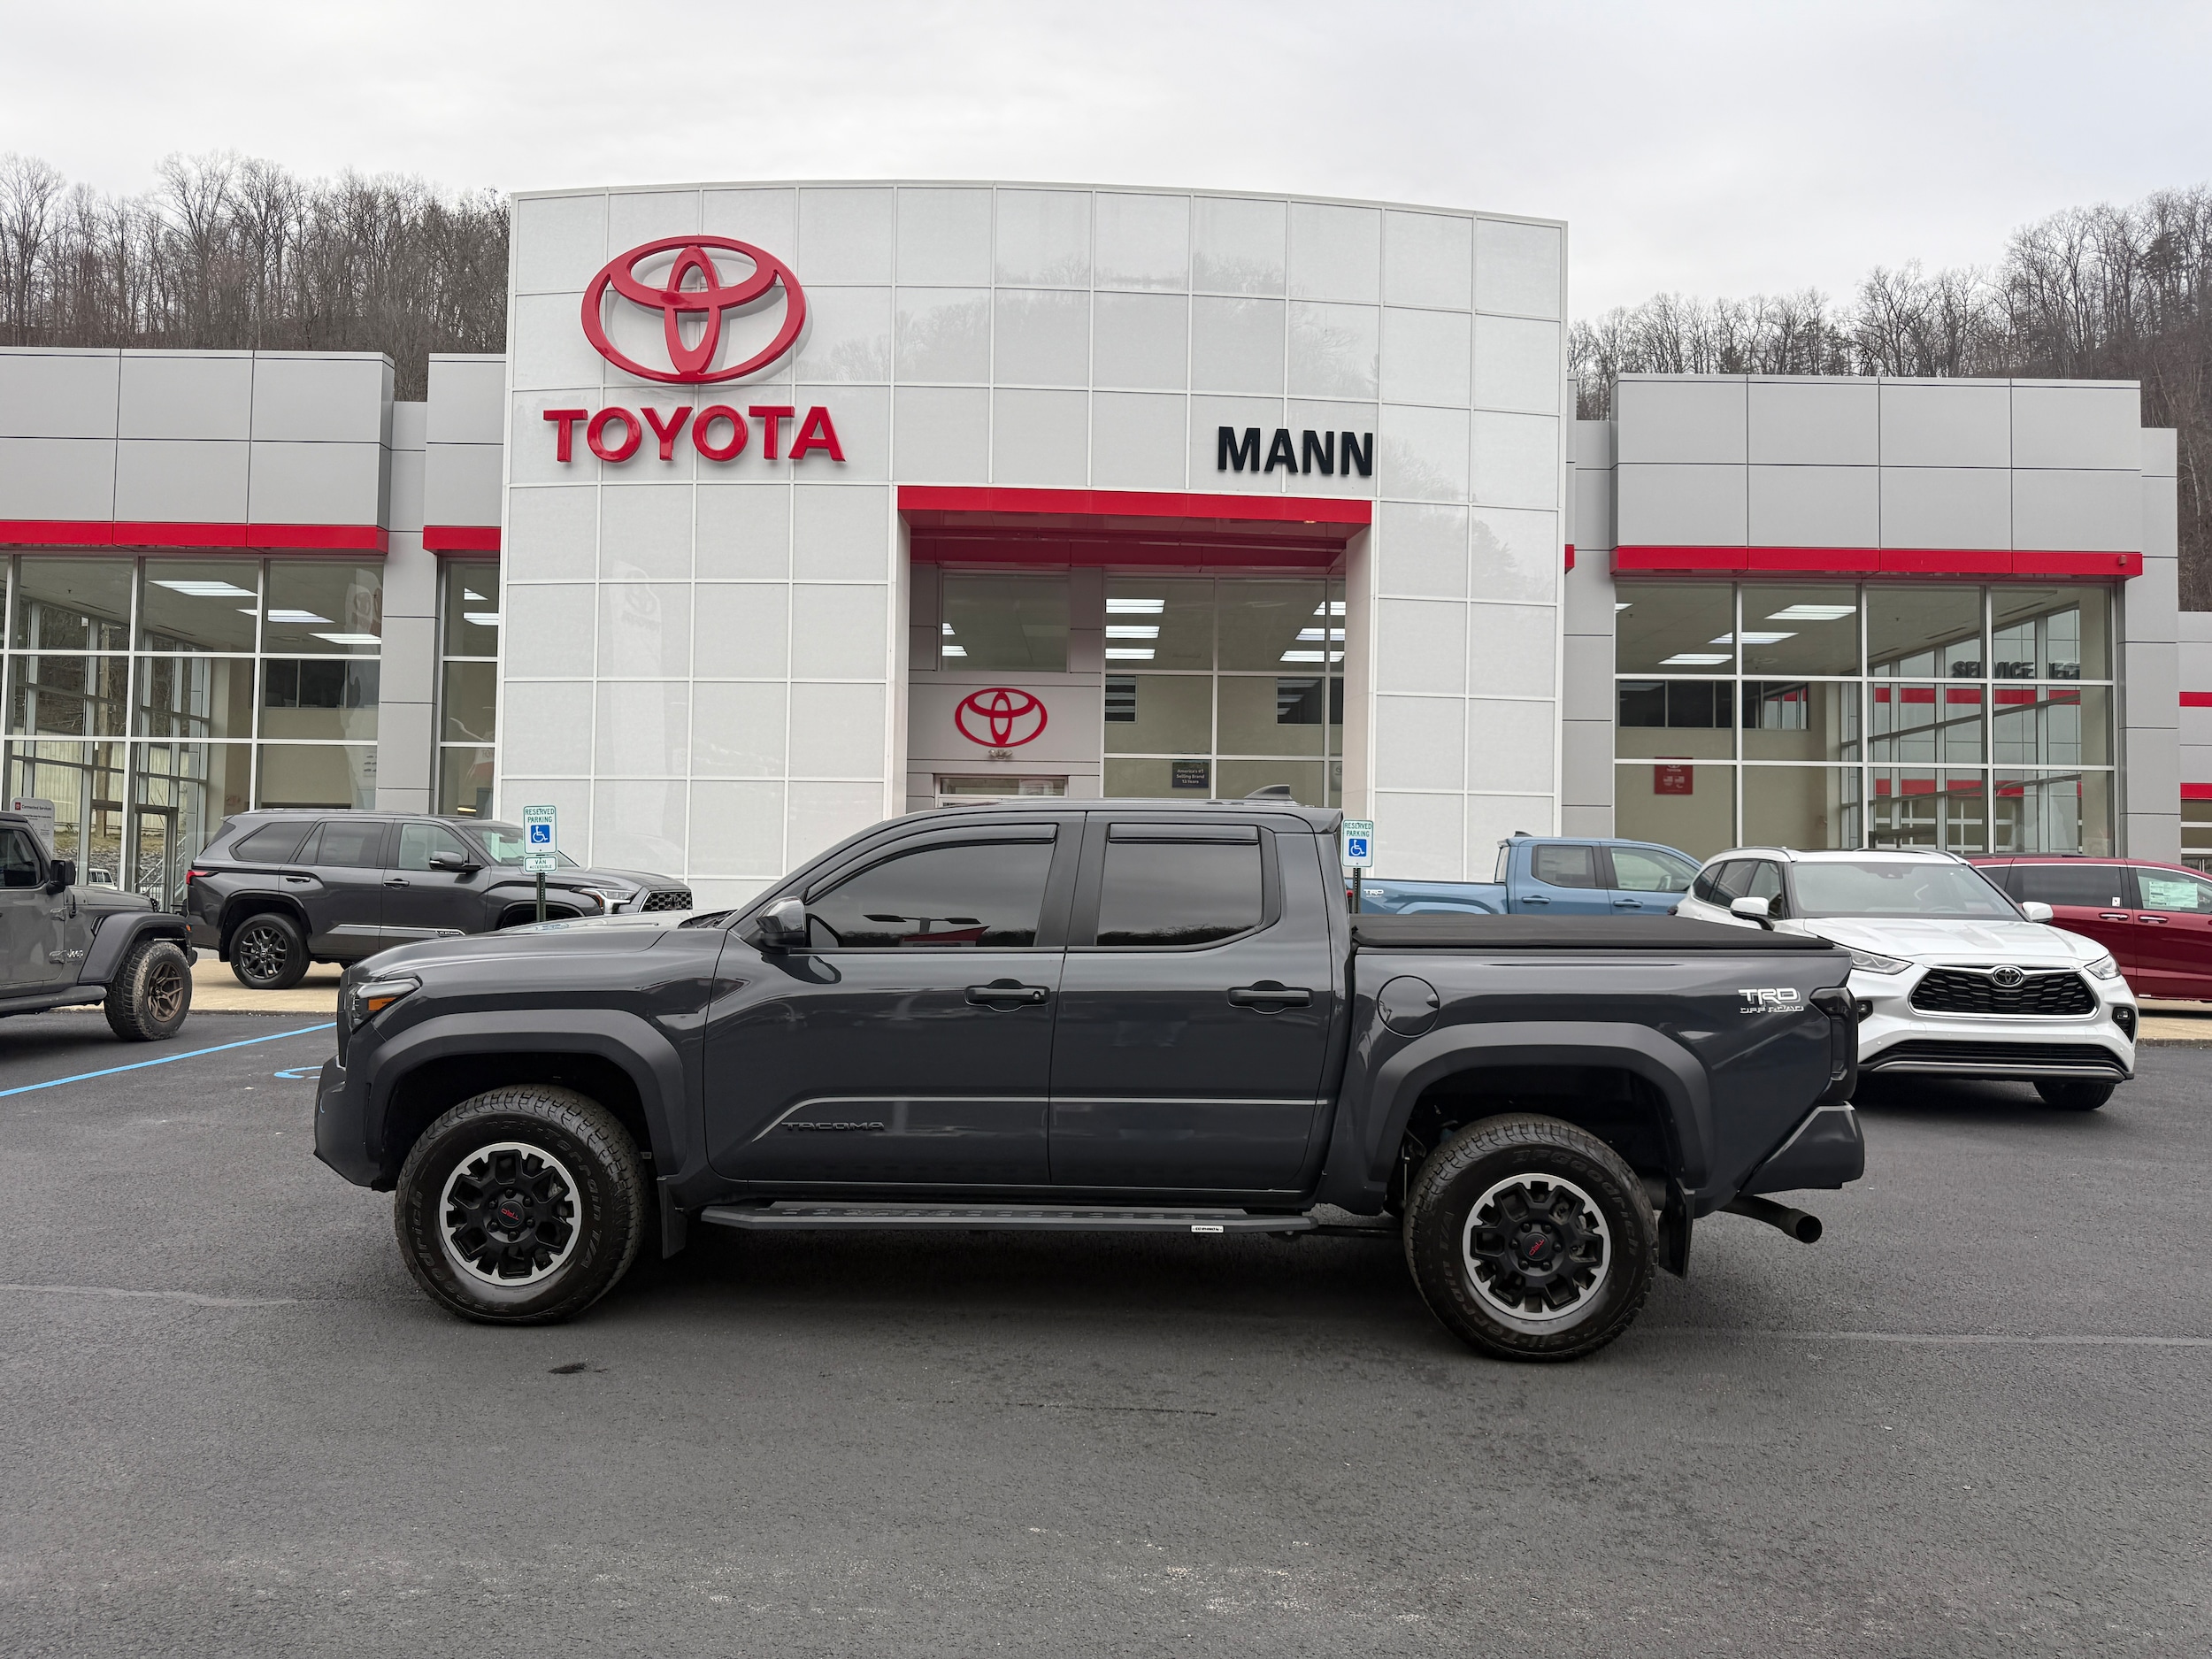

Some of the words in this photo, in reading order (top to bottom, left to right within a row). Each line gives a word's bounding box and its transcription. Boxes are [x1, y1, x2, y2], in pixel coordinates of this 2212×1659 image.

[543, 405, 847, 462] TOYOTA
[1218, 426, 1373, 476] MANN
[67, 949, 84, 958] Jeep
[1738, 987, 1801, 1005] TRD
[781, 1122, 885, 1131] TACOMA
